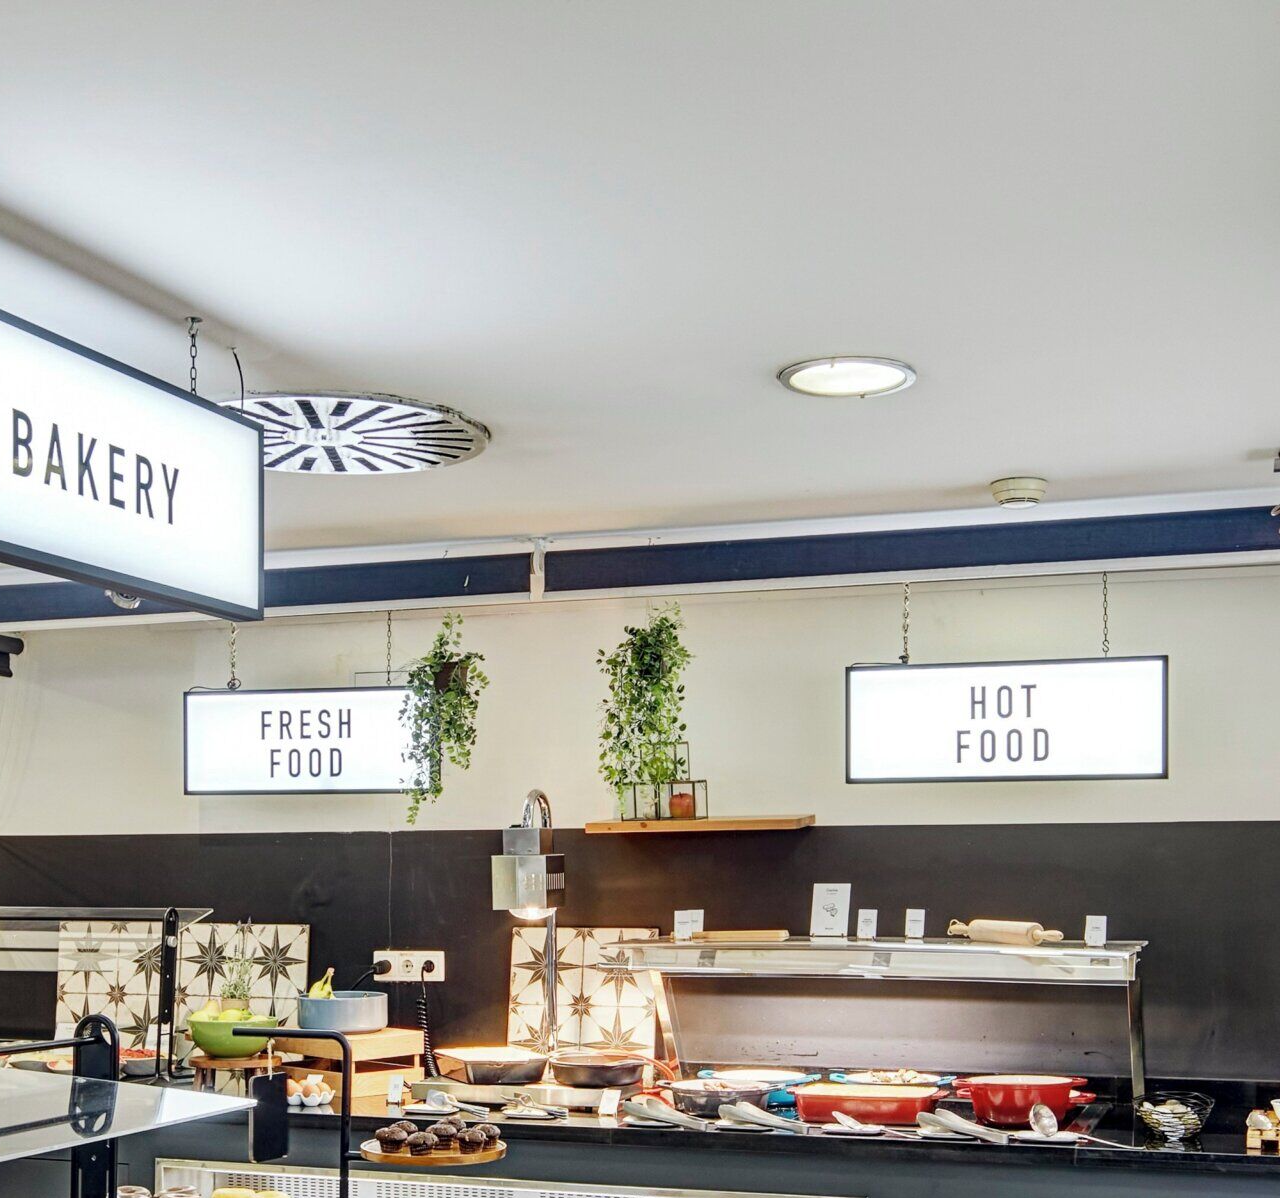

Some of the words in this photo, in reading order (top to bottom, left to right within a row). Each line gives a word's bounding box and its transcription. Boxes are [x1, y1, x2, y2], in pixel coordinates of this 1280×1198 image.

[11, 408, 180, 526] BAKERY
[969, 684, 1038, 720] HOT
[260, 708, 353, 741] FRESH
[269, 748, 343, 779] FOOD
[955, 728, 1051, 764] FOOD
